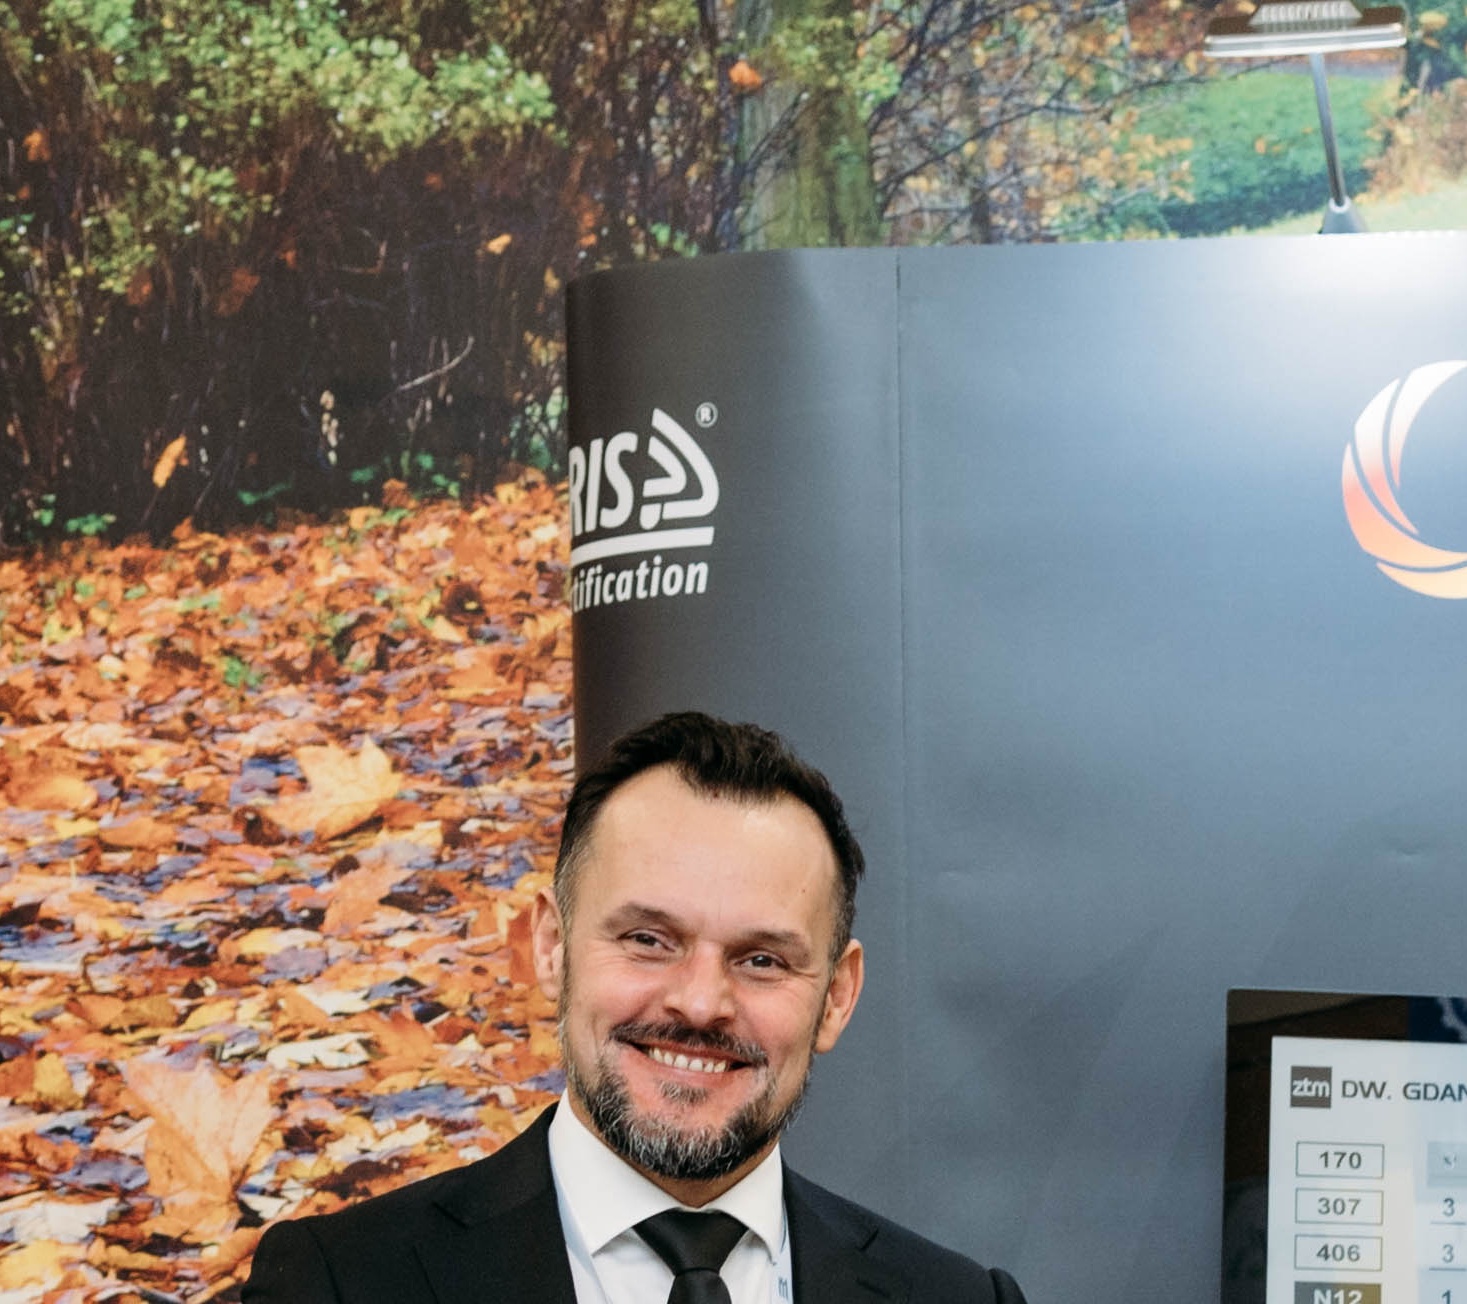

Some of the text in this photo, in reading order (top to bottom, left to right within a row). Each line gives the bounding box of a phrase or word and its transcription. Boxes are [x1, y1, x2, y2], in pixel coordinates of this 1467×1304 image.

[1291, 1076, 1331, 1098] ztm
[1341, 1079, 1392, 1101] DW.
[1319, 1151, 1363, 1170] 170
[1317, 1197, 1362, 1216] 307
[1442, 1197, 1456, 1217] 3
[1316, 1243, 1361, 1262] 406
[1441, 1243, 1455, 1264] 3
